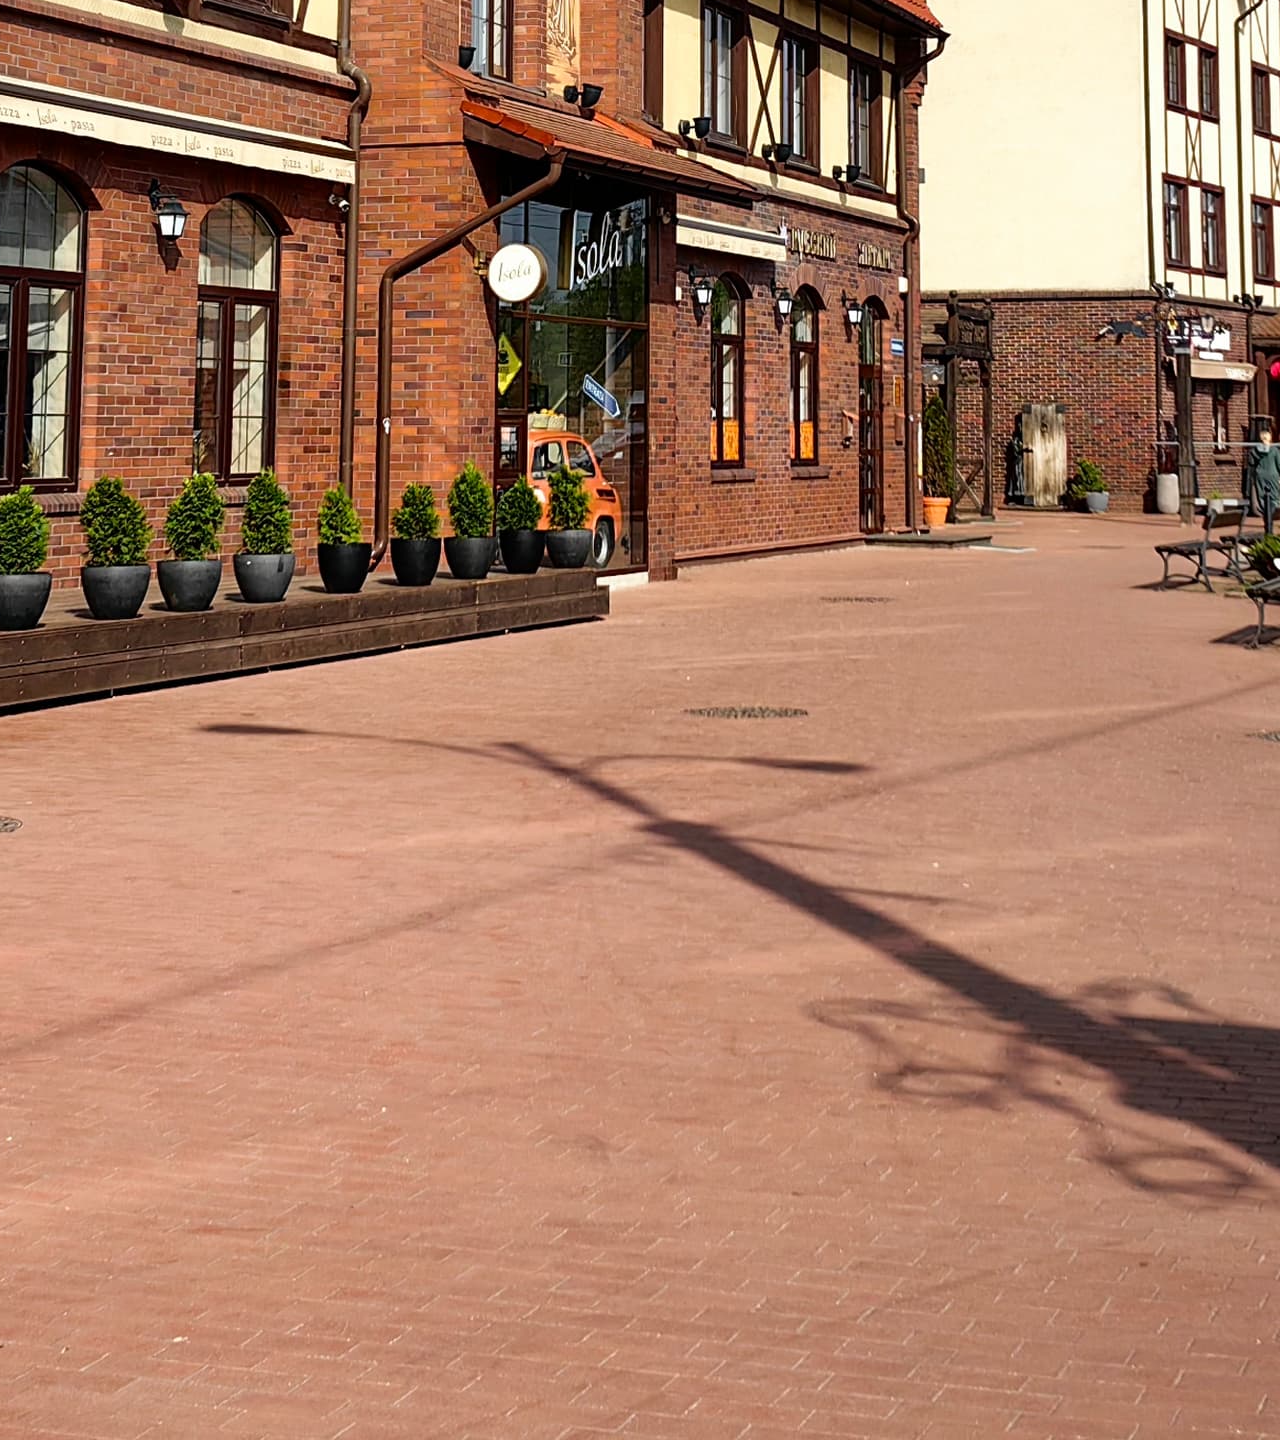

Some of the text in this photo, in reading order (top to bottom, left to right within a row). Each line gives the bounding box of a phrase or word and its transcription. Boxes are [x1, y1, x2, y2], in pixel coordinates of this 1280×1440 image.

[37, 107, 58, 126] Isola
[71, 120, 95, 132] pasta
[151, 134, 173, 146] pizza
[213, 146, 234, 158] pasta
[569, 209, 622, 291] Isola
[498, 260, 532, 283] Isola
